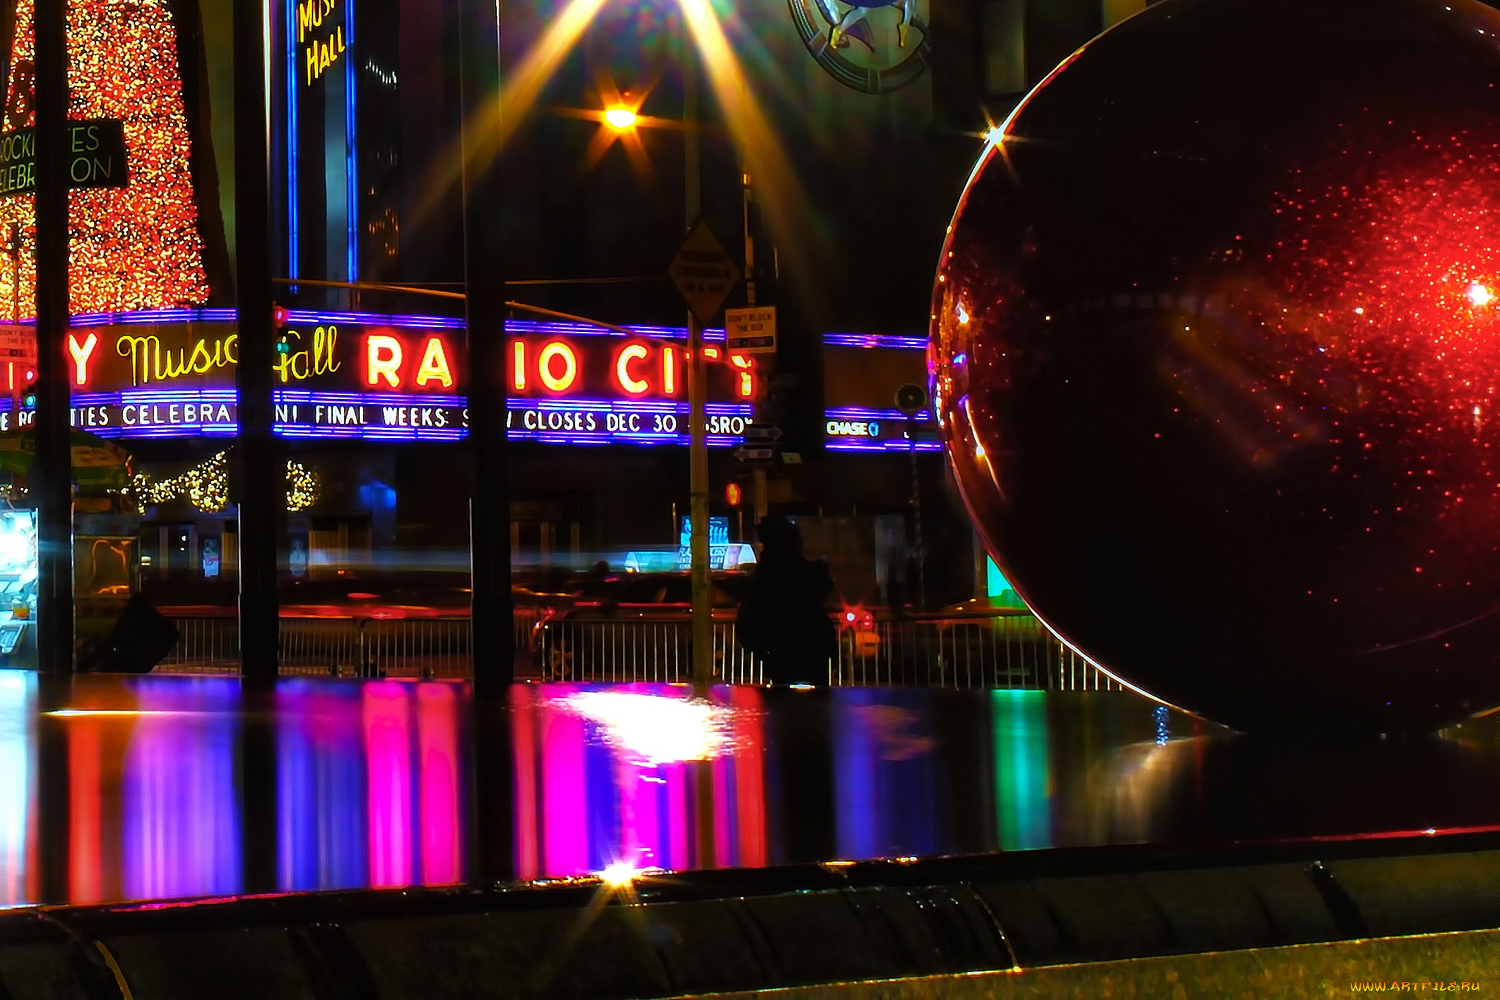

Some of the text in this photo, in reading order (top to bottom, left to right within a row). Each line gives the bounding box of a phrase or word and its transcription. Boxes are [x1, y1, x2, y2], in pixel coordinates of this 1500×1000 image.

[306, 25, 346, 87] HALL
[367, 335, 577, 392] RAIO
[315, 405, 368, 425] FINAL
[525, 411, 597, 431] CLOSES
[606, 413, 641, 432] DEC
[653, 415, 677, 433] 30
[826, 421, 869, 436] CHASE
